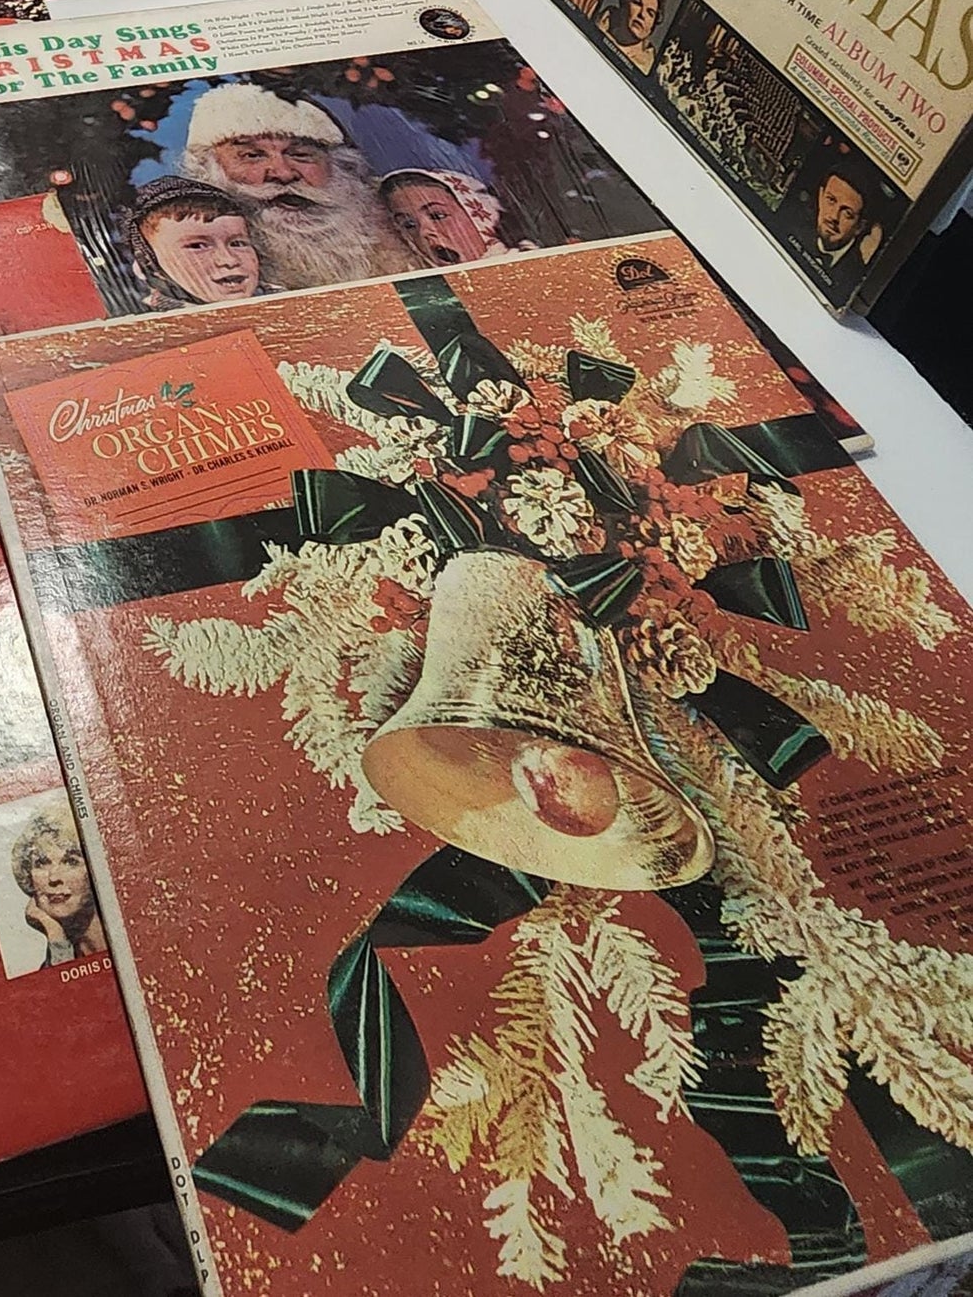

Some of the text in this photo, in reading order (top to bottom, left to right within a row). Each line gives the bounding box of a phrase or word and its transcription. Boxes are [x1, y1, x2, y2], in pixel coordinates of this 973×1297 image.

[39, 33, 109, 56] Day
[115, 19, 202, 47] Sings
[796, 1, 823, 29] TIME
[821, 21, 897, 90] ALBUM
[896, 80, 946, 134] TWO
[33, 66, 100, 90] The
[107, 52, 220, 81] Family
[792, 51, 899, 151] COLUMBIA SPECIAL PRODUCTS
[828, 57, 865, 93] exclusively
[620, 264, 655, 281] Dot
[48, 388, 156, 444] Christmas
[92, 398, 272, 460] ORGAN AND
[136, 413, 287, 477] CHIMES
[84, 438, 295, 508] DR. NORMAN S. WRIGHT DR. CHARLES S. KENDALL
[49, 699, 89, 820] ORGAN AND CHIMES
[60, 961, 101, 983] DORIS
[170, 1156, 210, 1284] DOT DLP
